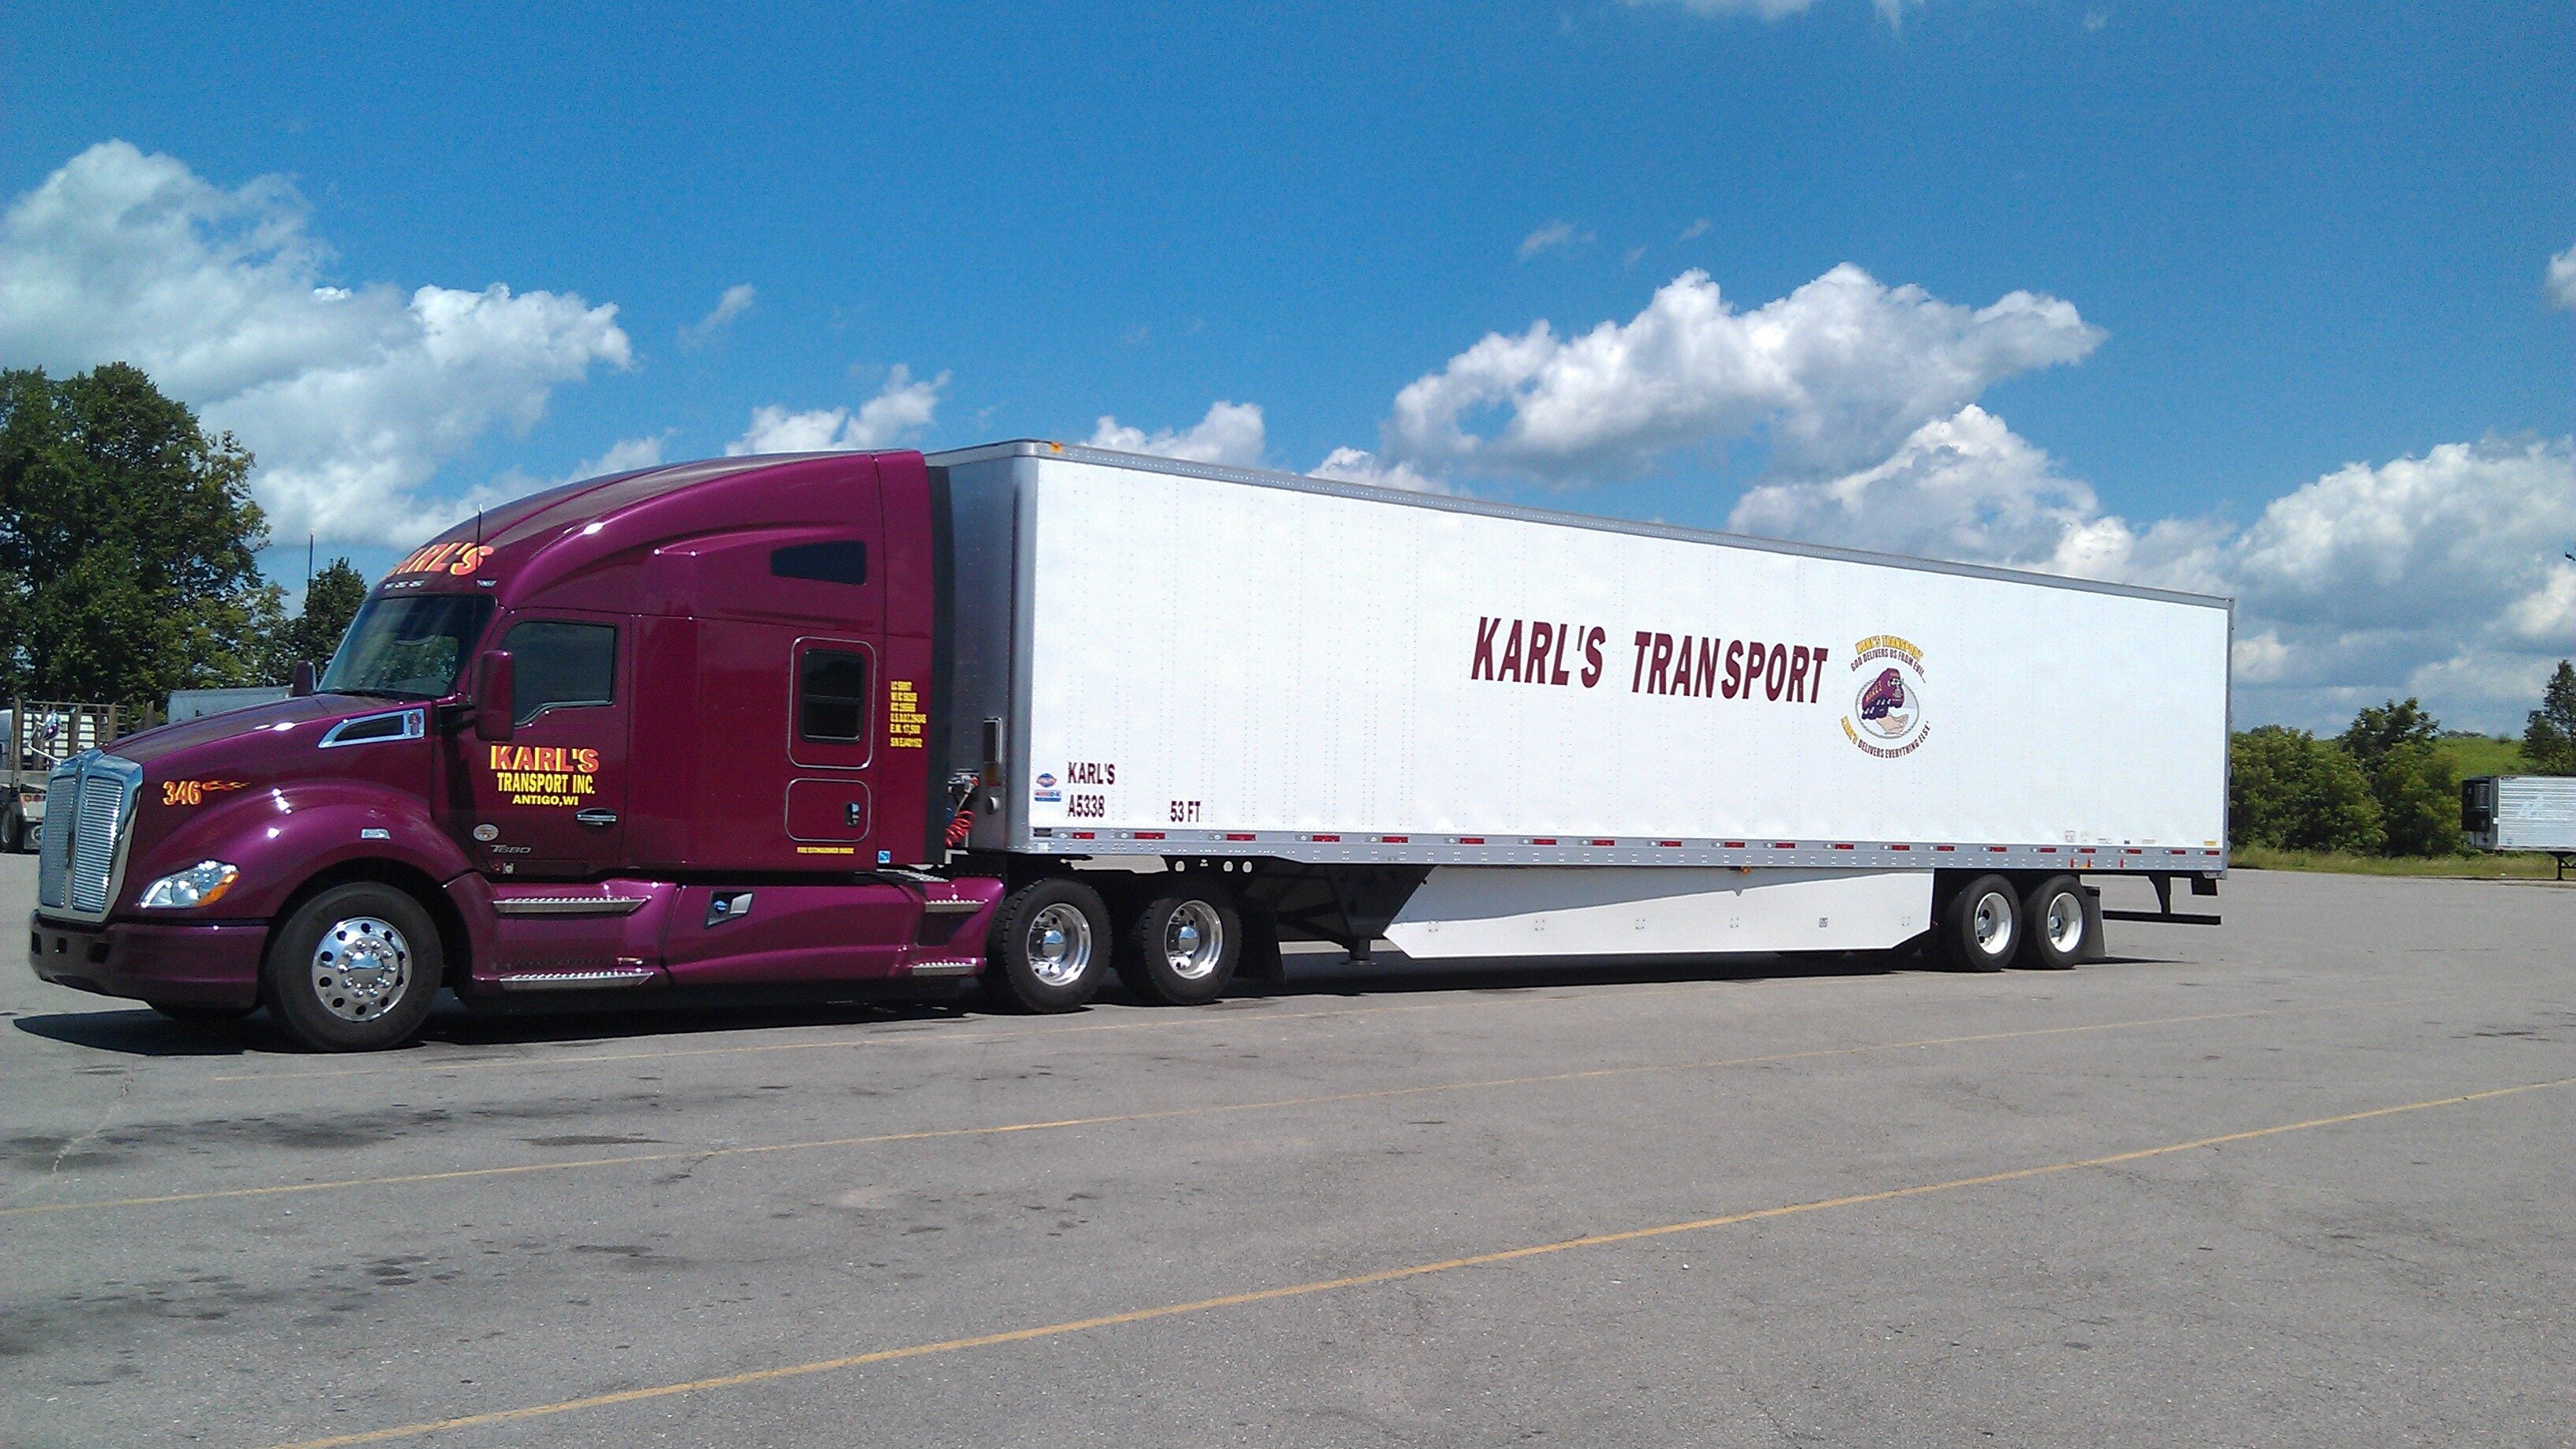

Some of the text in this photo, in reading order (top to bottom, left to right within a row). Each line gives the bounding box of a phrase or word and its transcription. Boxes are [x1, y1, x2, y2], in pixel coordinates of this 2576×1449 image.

[382, 542, 494, 578] ARL'S
[1471, 616, 1829, 704] KARL'S TRANSPORT
[1850, 656, 1863, 672] GOD
[1863, 648, 1889, 663] DELIVERS
[1889, 649, 1897, 659] US
[1898, 650, 1914, 668] FROM
[1881, 635, 1923, 661] TRANSPORT
[490, 745, 599, 773] KARL'S
[1857, 739, 1885, 758] DELIVERS
[1885, 739, 1919, 758] EVERYTHING
[496, 772, 596, 794] TRANSPORT INC.
[1068, 762, 1115, 785] KARL'S
[163, 781, 202, 805] 346
[1067, 794, 1105, 818] A5338
[1170, 800, 1201, 822] 53 FT
